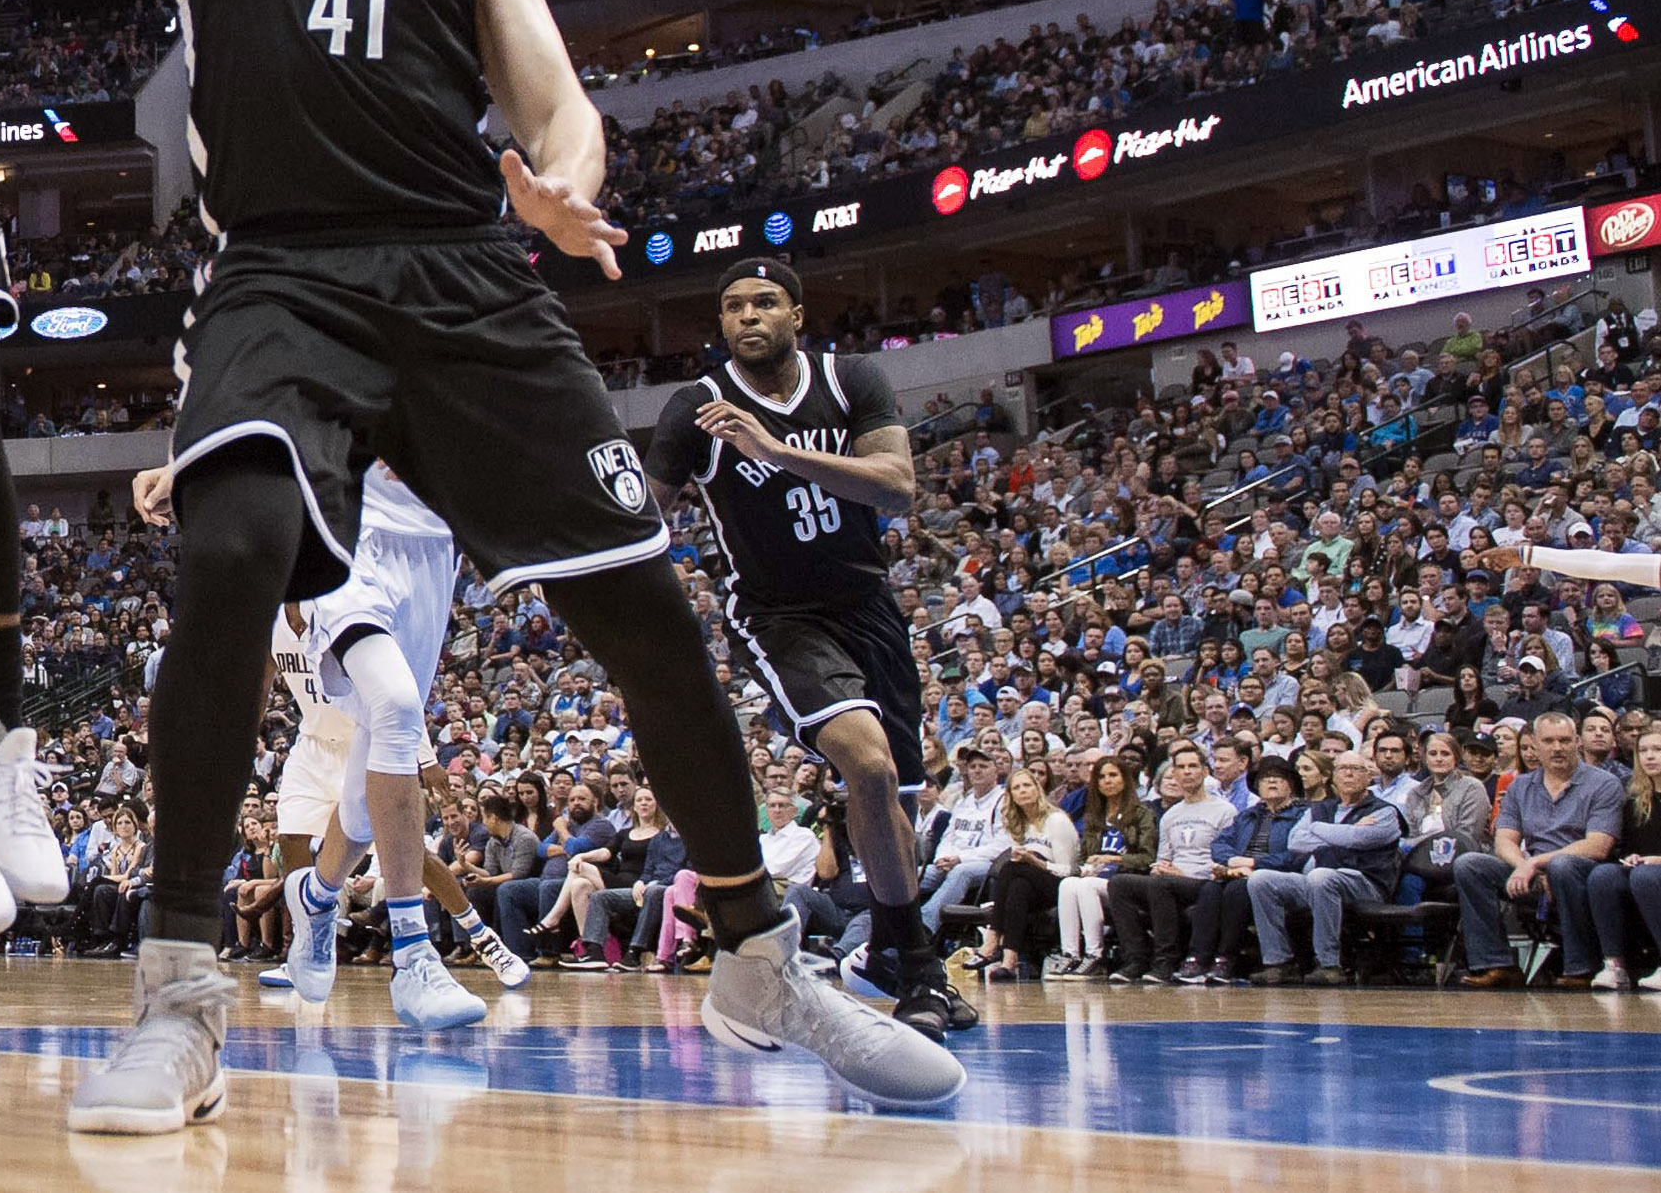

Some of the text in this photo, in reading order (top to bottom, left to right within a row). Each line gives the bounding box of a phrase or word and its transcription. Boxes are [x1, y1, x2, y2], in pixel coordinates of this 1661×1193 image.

[1342, 25, 1592, 109] American Airlines
[1114, 115, 1221, 164] Pizza Hut
[970, 154, 1068, 200] Pizza Hut
[812, 202, 861, 232] AT&T
[1607, 212, 1648, 245] Pepper
[1618, 209, 1637, 221] Dr
[693, 225, 743, 253] AT&T
[1484, 229, 1576, 268] BEST
[1369, 254, 1456, 290] BEST
[1262, 276, 1341, 310] BEST
[47, 311, 91, 333] Ford
[594, 444, 640, 479] NETS
[786, 483, 840, 541] 35
[276, 653, 313, 673] DALL
